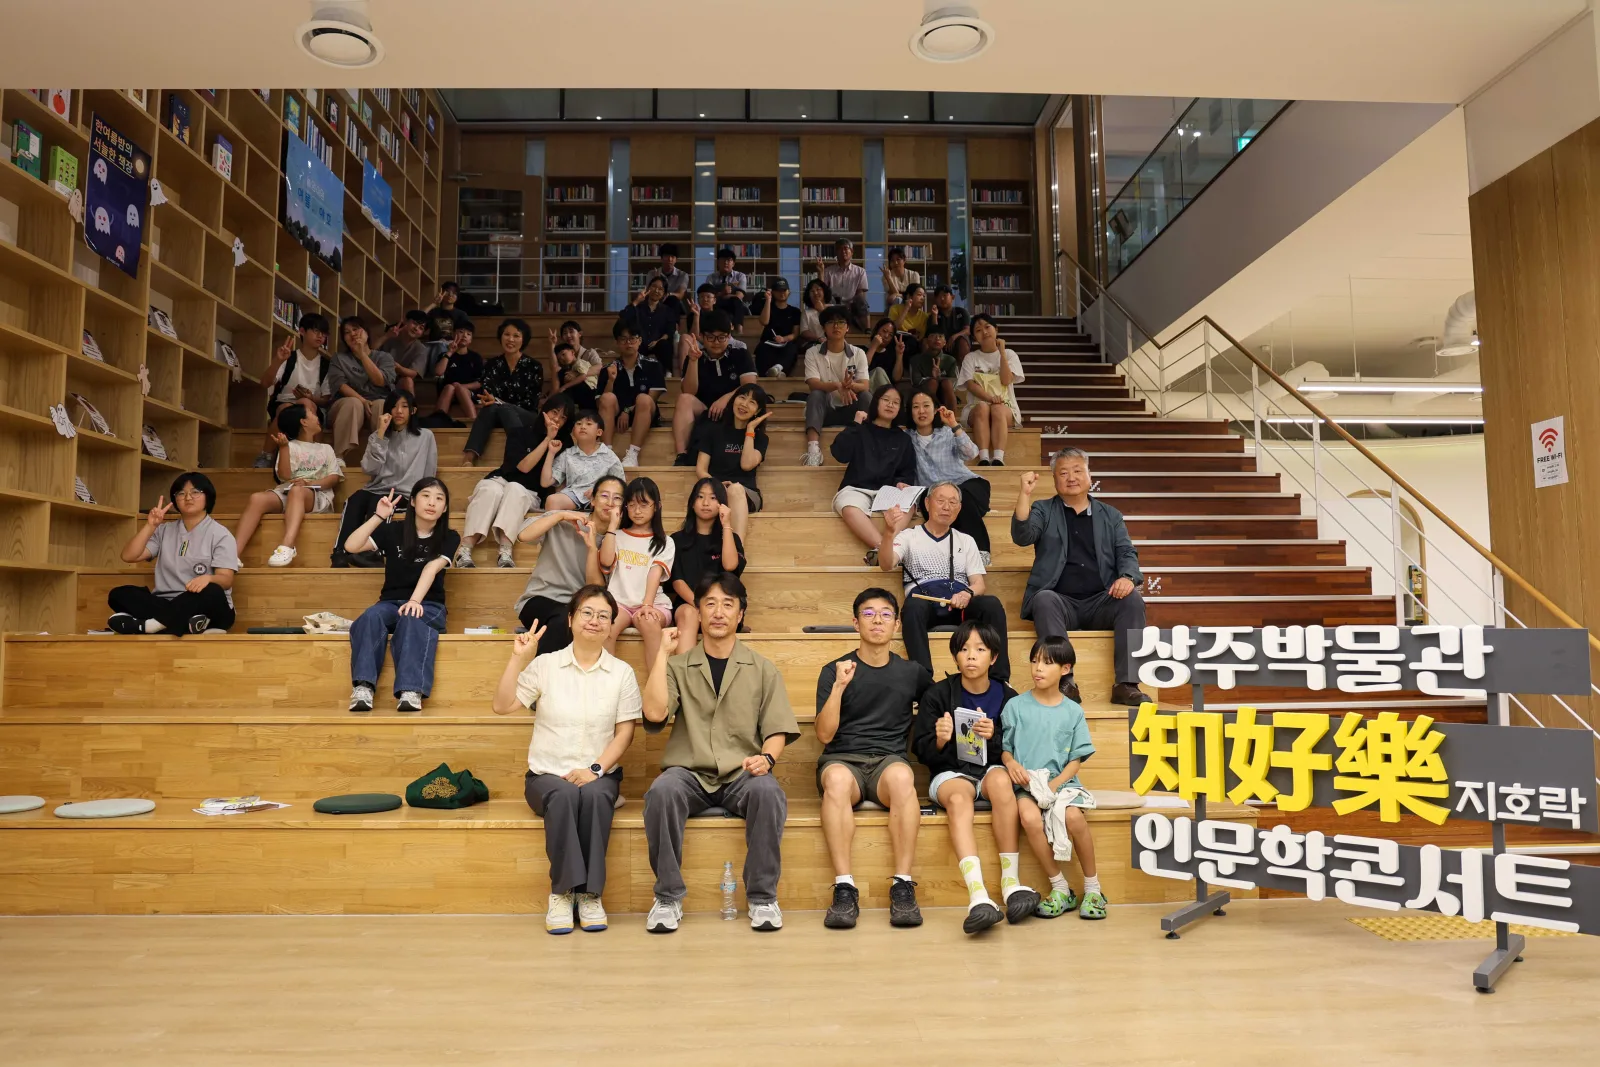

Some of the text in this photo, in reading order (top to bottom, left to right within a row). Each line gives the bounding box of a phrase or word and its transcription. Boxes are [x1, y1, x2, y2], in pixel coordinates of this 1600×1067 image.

[93, 137, 133, 174] 서늘한 책장
[95, 119, 133, 157] 한여름밤의
[1536, 452, 1563, 463] FREE WI-FI
[1132, 625, 1494, 697] 상주박물관
[1131, 702, 1451, 825] 知好樂
[1455, 780, 1587, 830] 지호락
[1134, 813, 1580, 933] 인문학콘서트
